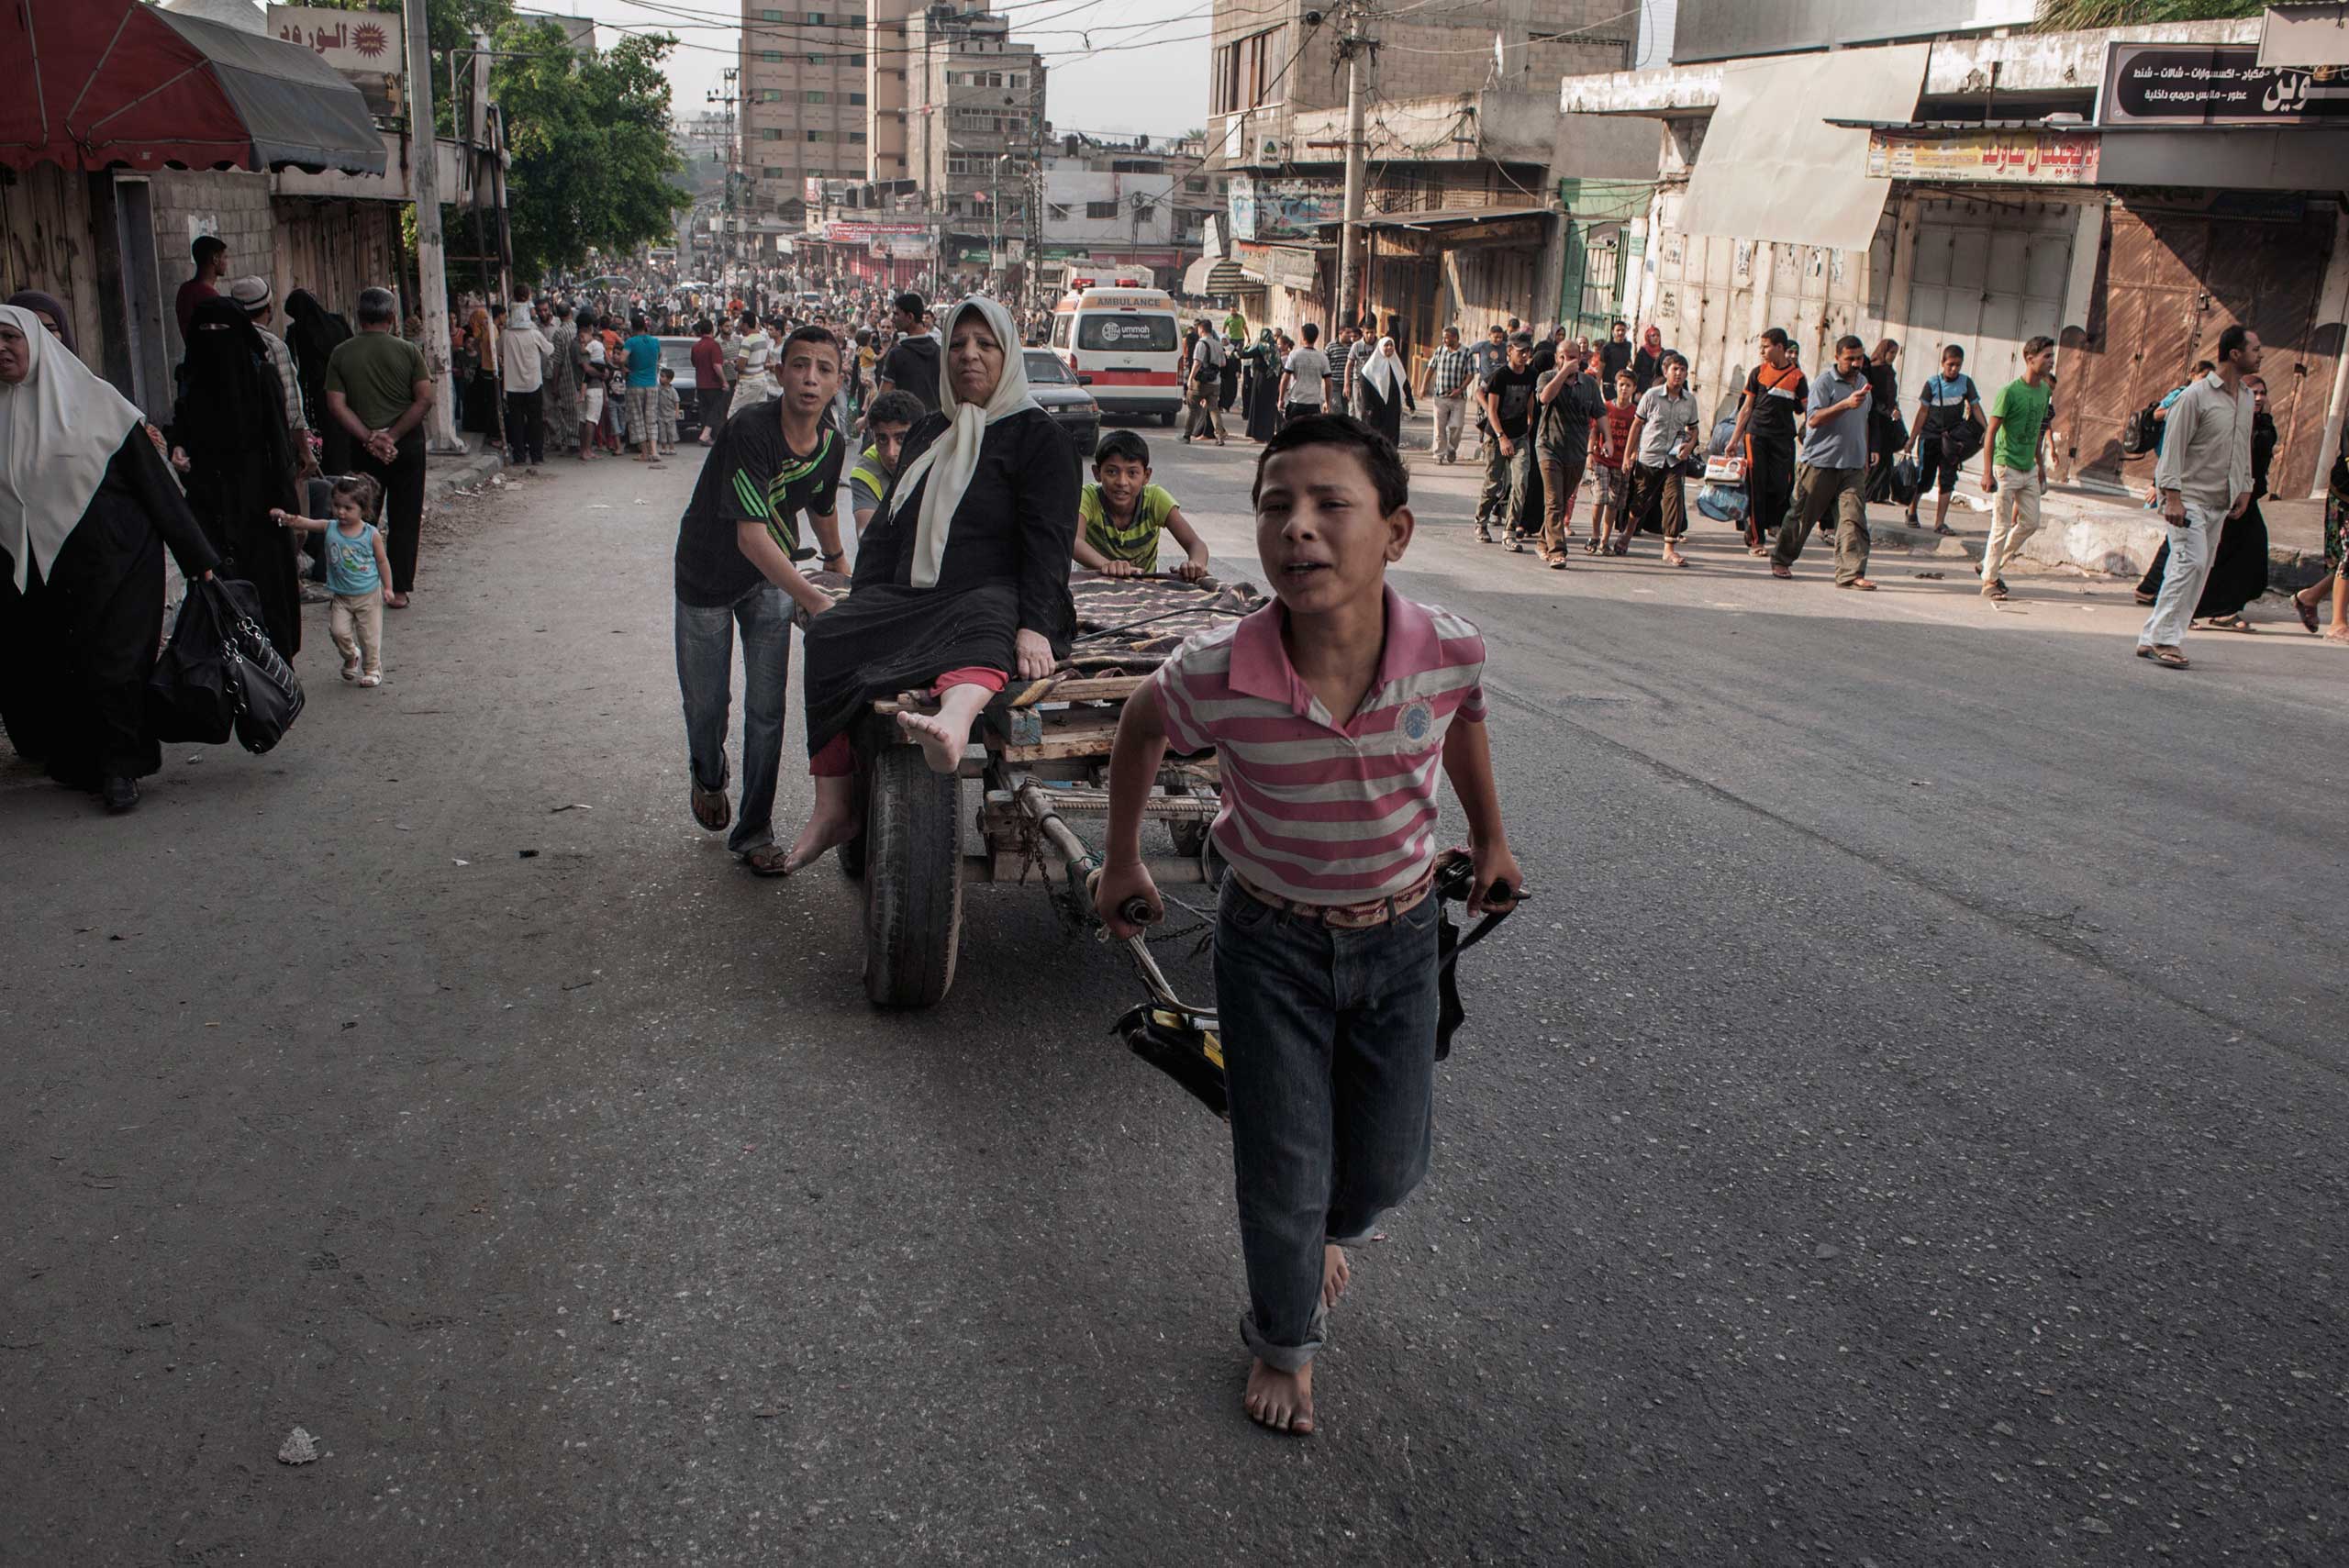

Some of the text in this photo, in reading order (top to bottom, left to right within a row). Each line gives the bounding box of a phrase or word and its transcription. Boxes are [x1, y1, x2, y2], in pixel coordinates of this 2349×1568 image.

[2132, 66, 2153, 78] شنط
[2160, 65, 2184, 78] شالات
[2191, 67, 2235, 79] اكسسوارات
[2144, 89, 2247, 101] عطور ملابس حريمي داخلية
[1097, 297, 1161, 307] AMBULANCE
[1121, 326, 1151, 334] ummah
